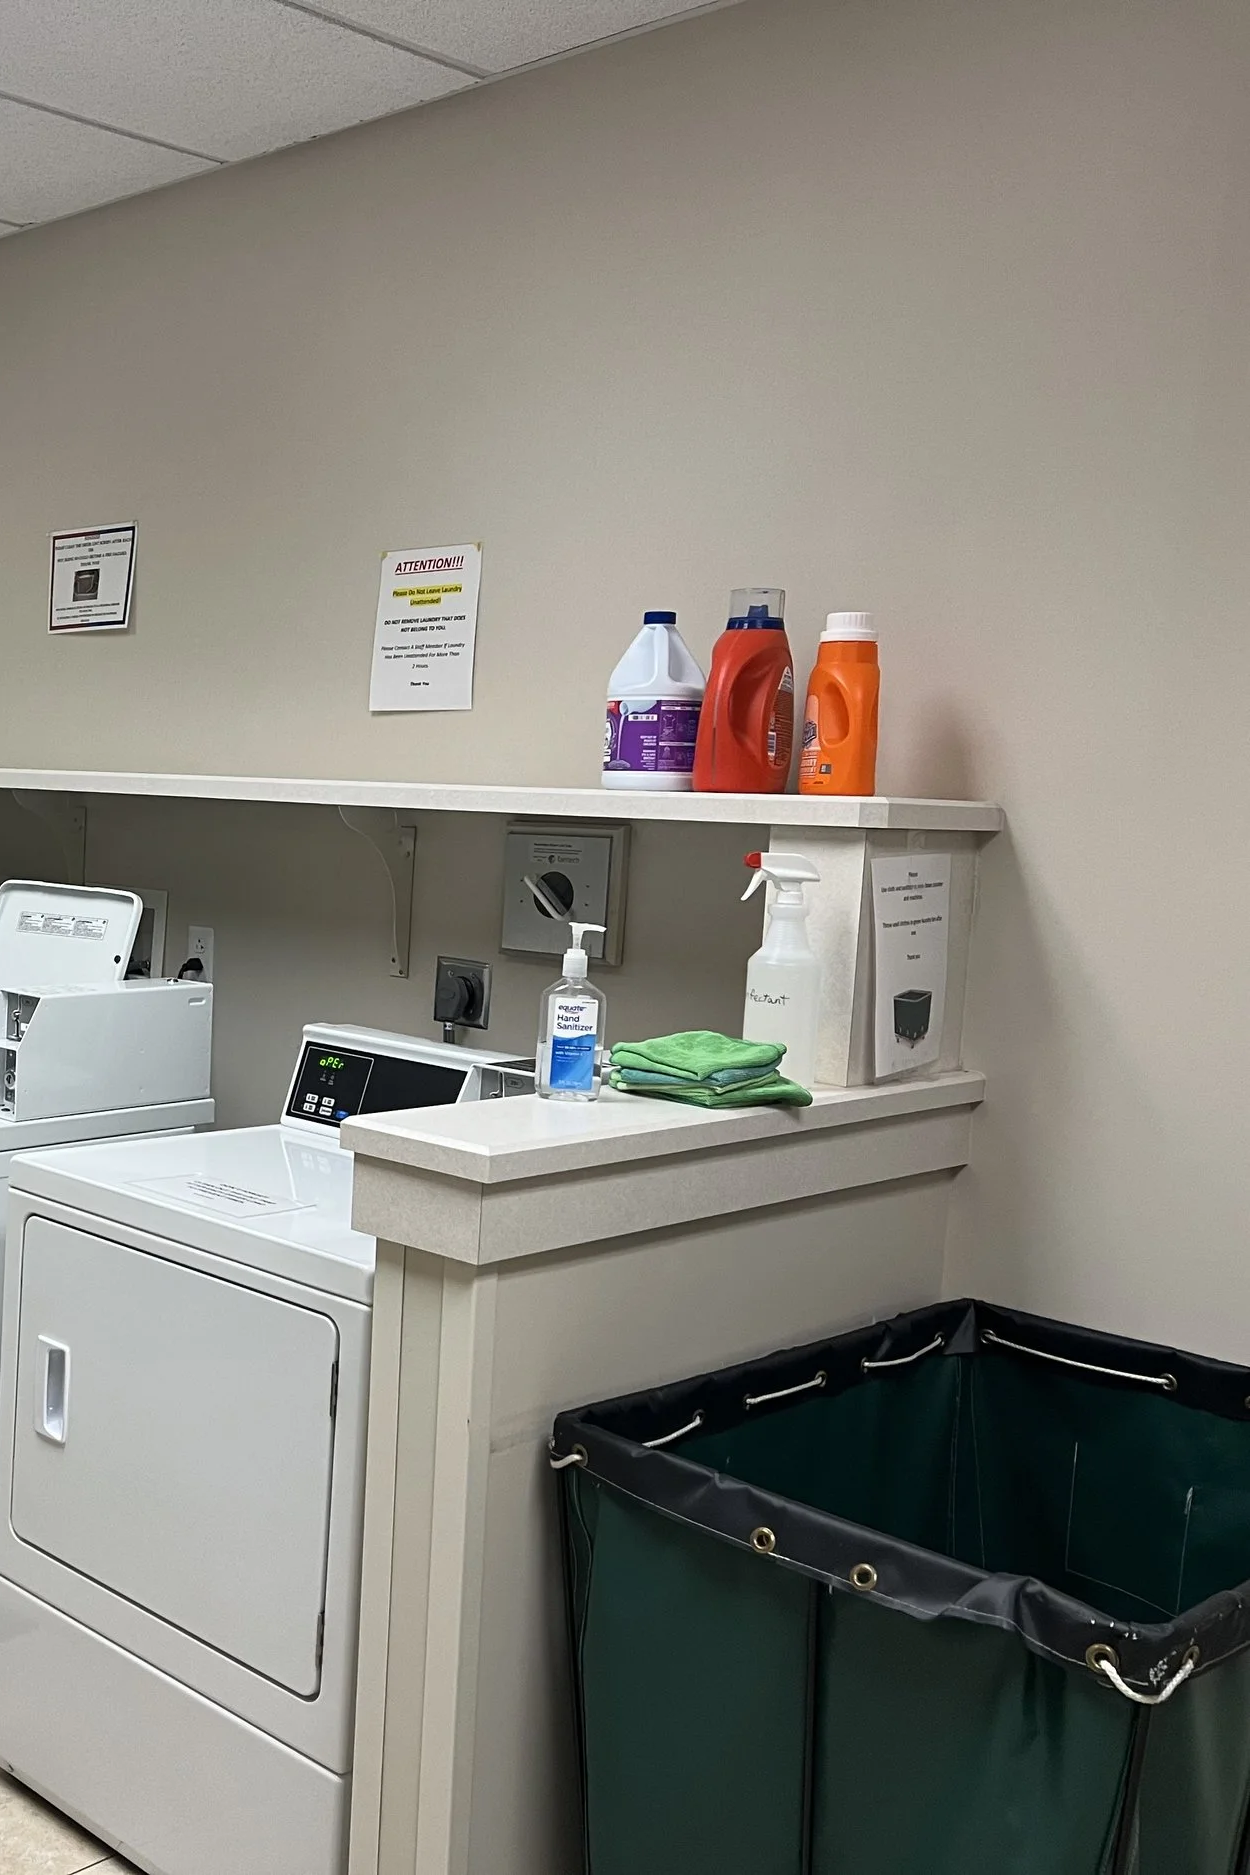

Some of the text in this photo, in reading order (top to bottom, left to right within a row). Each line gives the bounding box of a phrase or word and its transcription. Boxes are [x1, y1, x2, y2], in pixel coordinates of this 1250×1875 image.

[395, 556, 464, 574] ATTENTION!!!
[442, 585, 462, 593] Laundry
[558, 1005, 587, 1013] equate
[557, 1014, 580, 1022] Hand
[557, 1022, 593, 1031] Sanitizer
